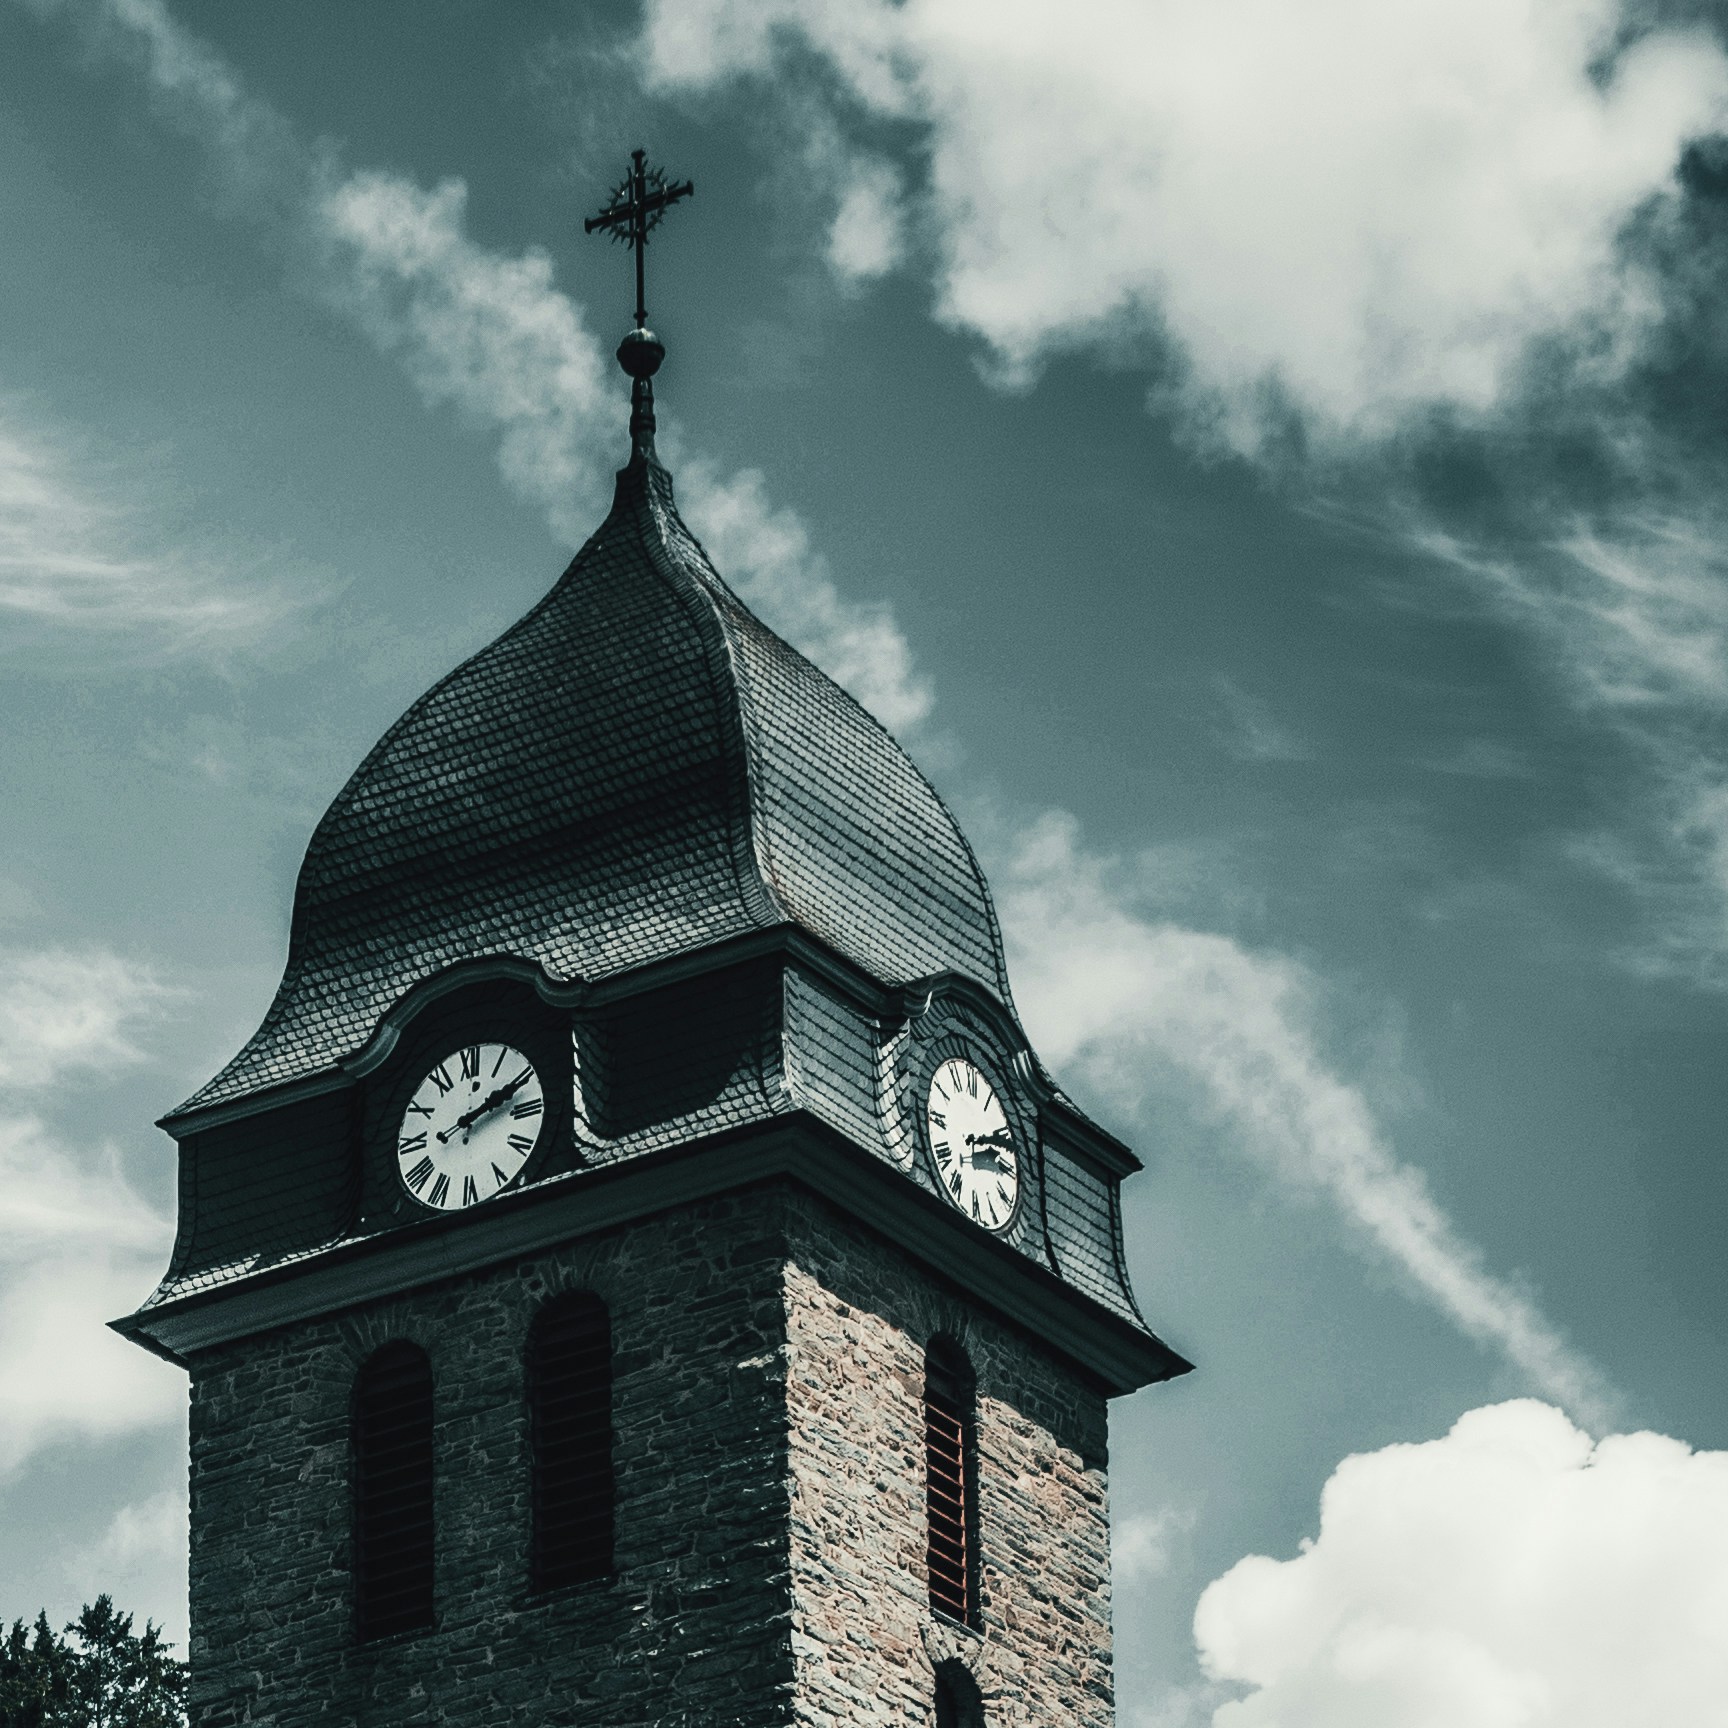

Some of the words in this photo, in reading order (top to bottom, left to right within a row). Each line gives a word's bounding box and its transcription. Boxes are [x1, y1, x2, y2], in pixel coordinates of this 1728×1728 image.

[428, 1064, 454, 1098] XI
[460, 1046, 481, 1082] XII
[407, 1100, 435, 1120] X
